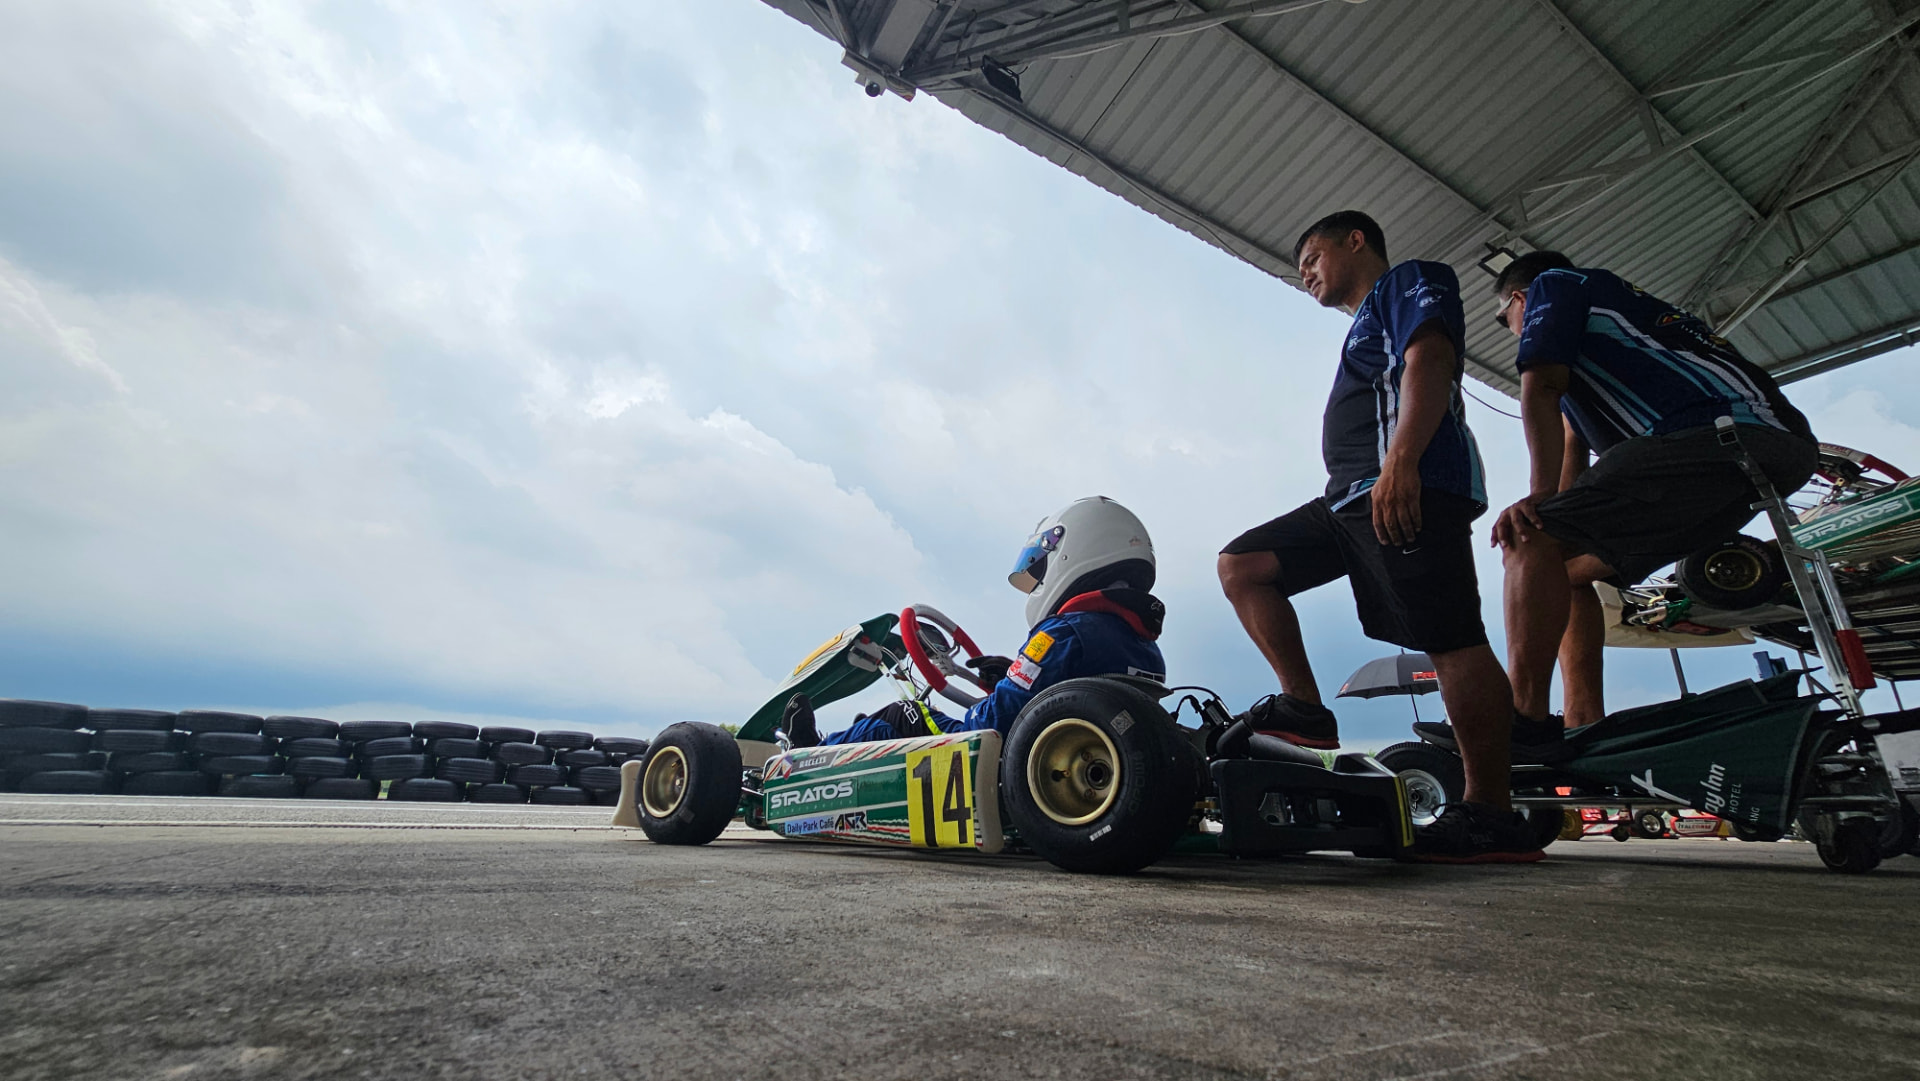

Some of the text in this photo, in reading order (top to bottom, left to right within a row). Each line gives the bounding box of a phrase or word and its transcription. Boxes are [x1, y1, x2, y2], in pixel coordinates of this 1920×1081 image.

[1797, 500, 1903, 543] STRATOS
[1700, 764, 1726, 791] Inn
[771, 781, 853, 809] STRATOS
[913, 750, 971, 847] 14
[1729, 783, 1742, 814] HOTEL
[787, 822, 802, 834] Daily
[803, 819, 818, 830] Park
[819, 816, 834, 829] Café
